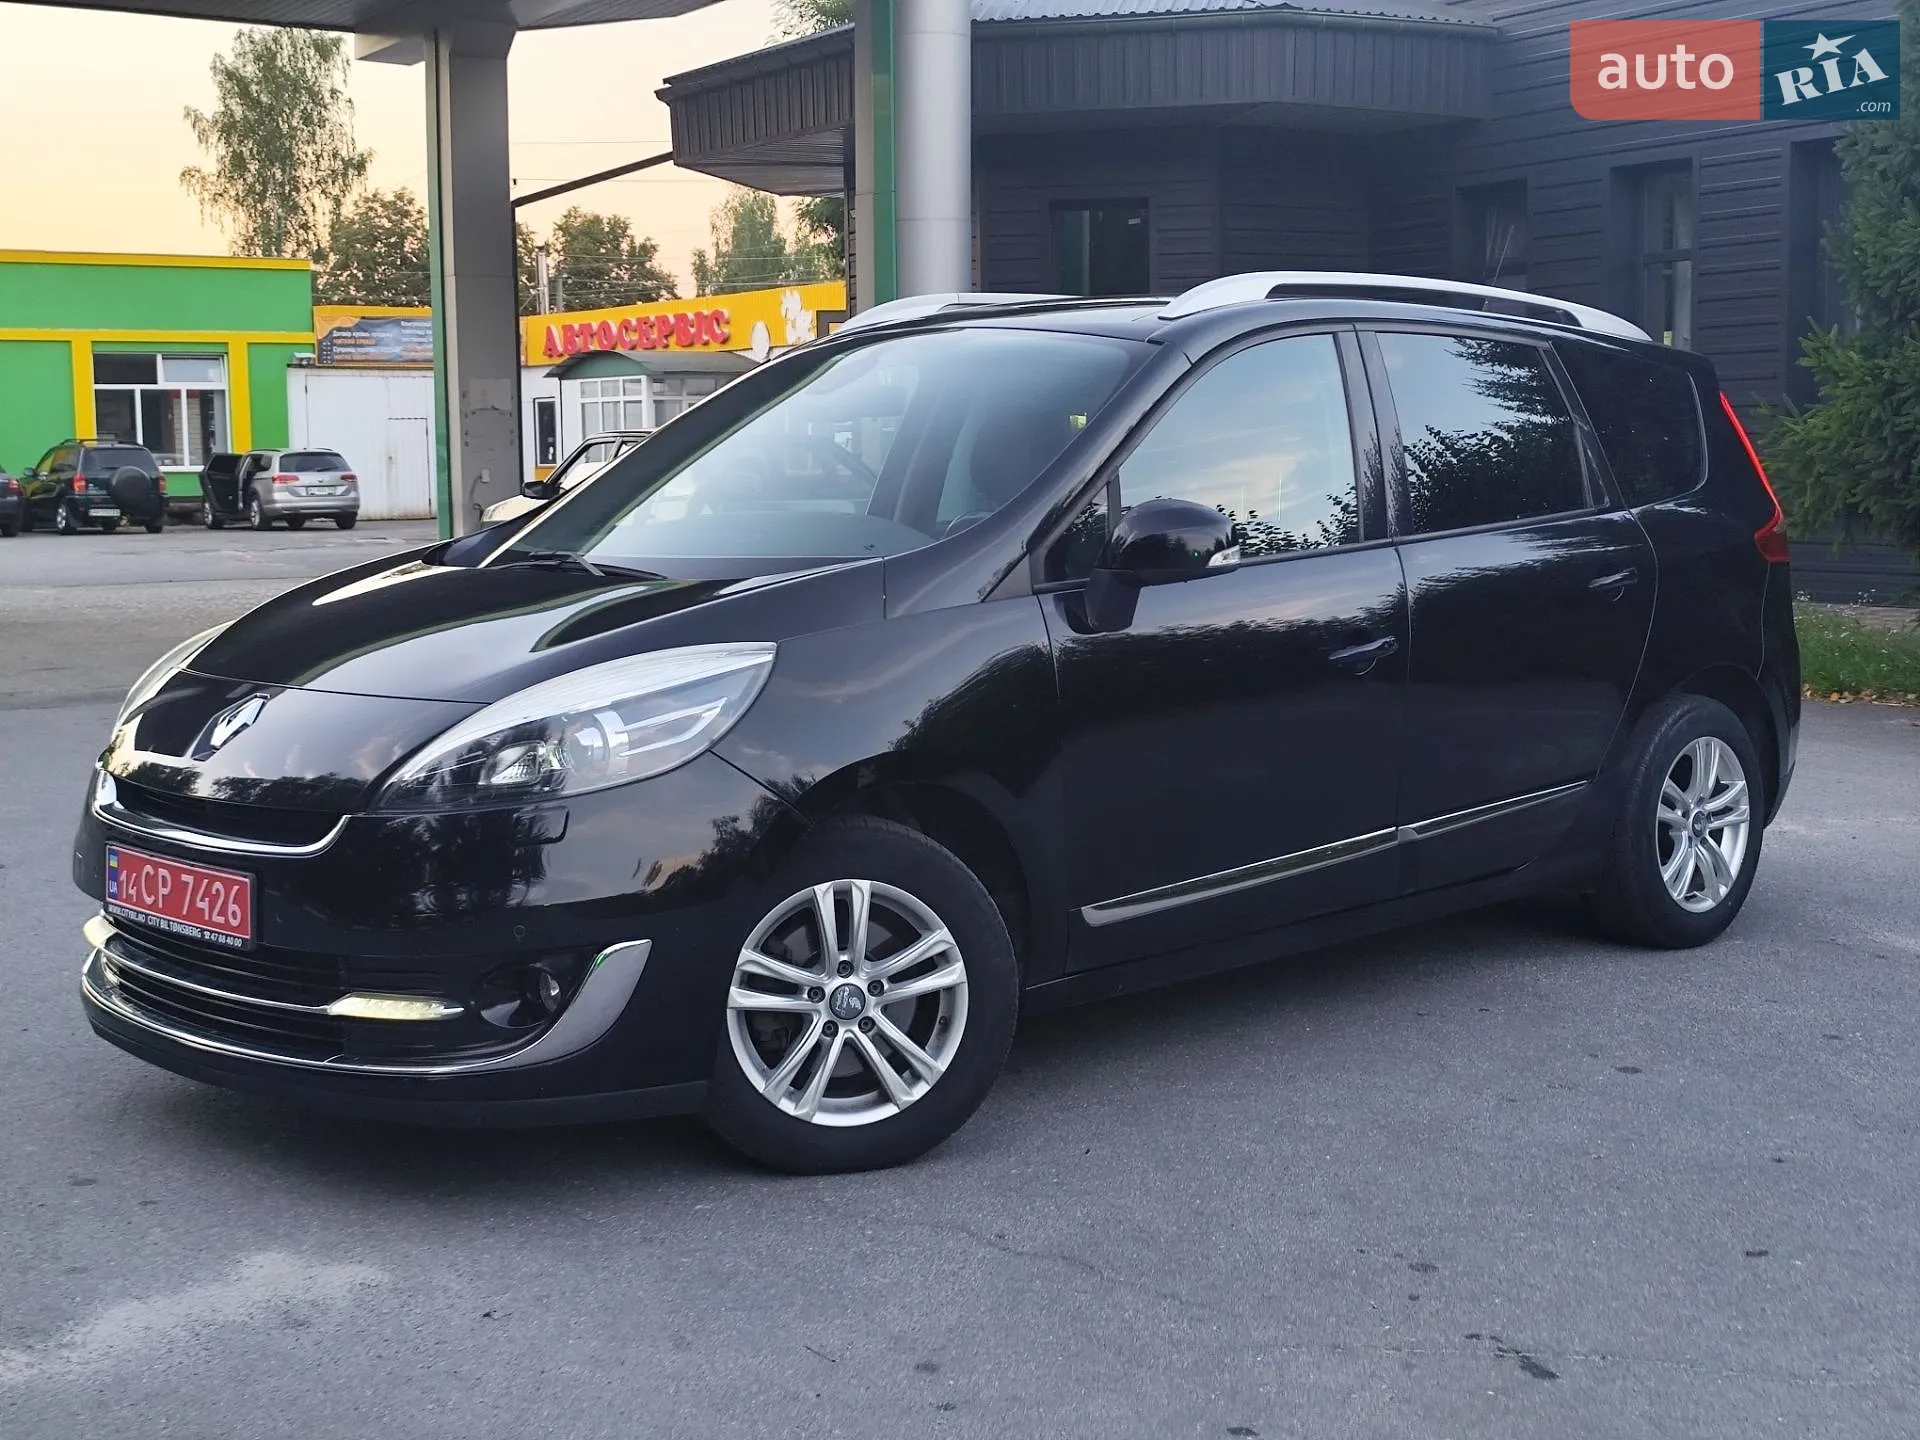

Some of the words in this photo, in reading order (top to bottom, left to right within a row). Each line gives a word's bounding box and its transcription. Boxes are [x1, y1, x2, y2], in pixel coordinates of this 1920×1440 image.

[543, 309, 730, 358] АВТОСЕРВІС
[109, 880, 118, 895] UA
[181, 874, 242, 927] 7426
[147, 915, 160, 927] CITY
